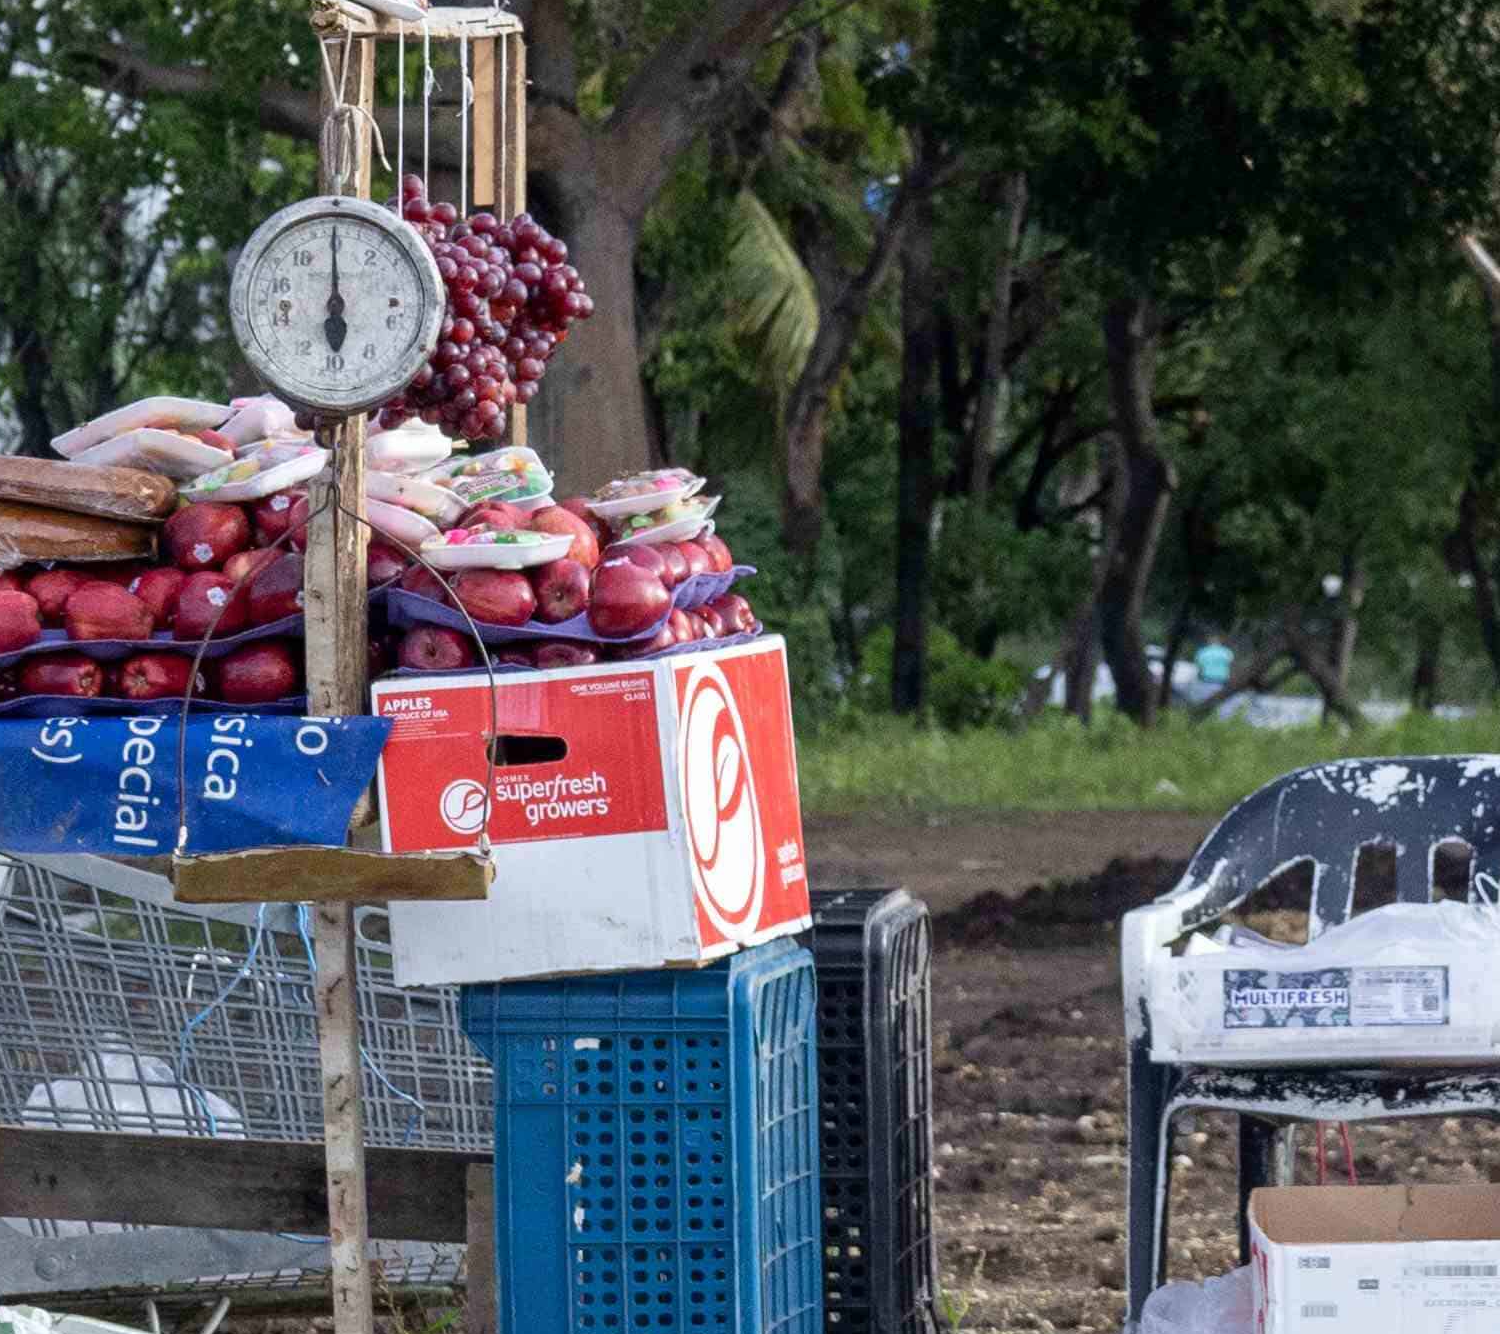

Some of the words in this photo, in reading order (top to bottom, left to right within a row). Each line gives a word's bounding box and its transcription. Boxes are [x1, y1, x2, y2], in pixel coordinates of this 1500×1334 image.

[363, 250, 377, 266] 2
[271, 277, 291, 294] 16
[325, 354, 345, 370] 10
[383, 697, 433, 712] APPLES
[203, 712, 260, 800] sica
[496, 771, 607, 806] superfresh
[525, 797, 609, 827] growers
[1233, 990, 1346, 1006] MULTIFRESH
